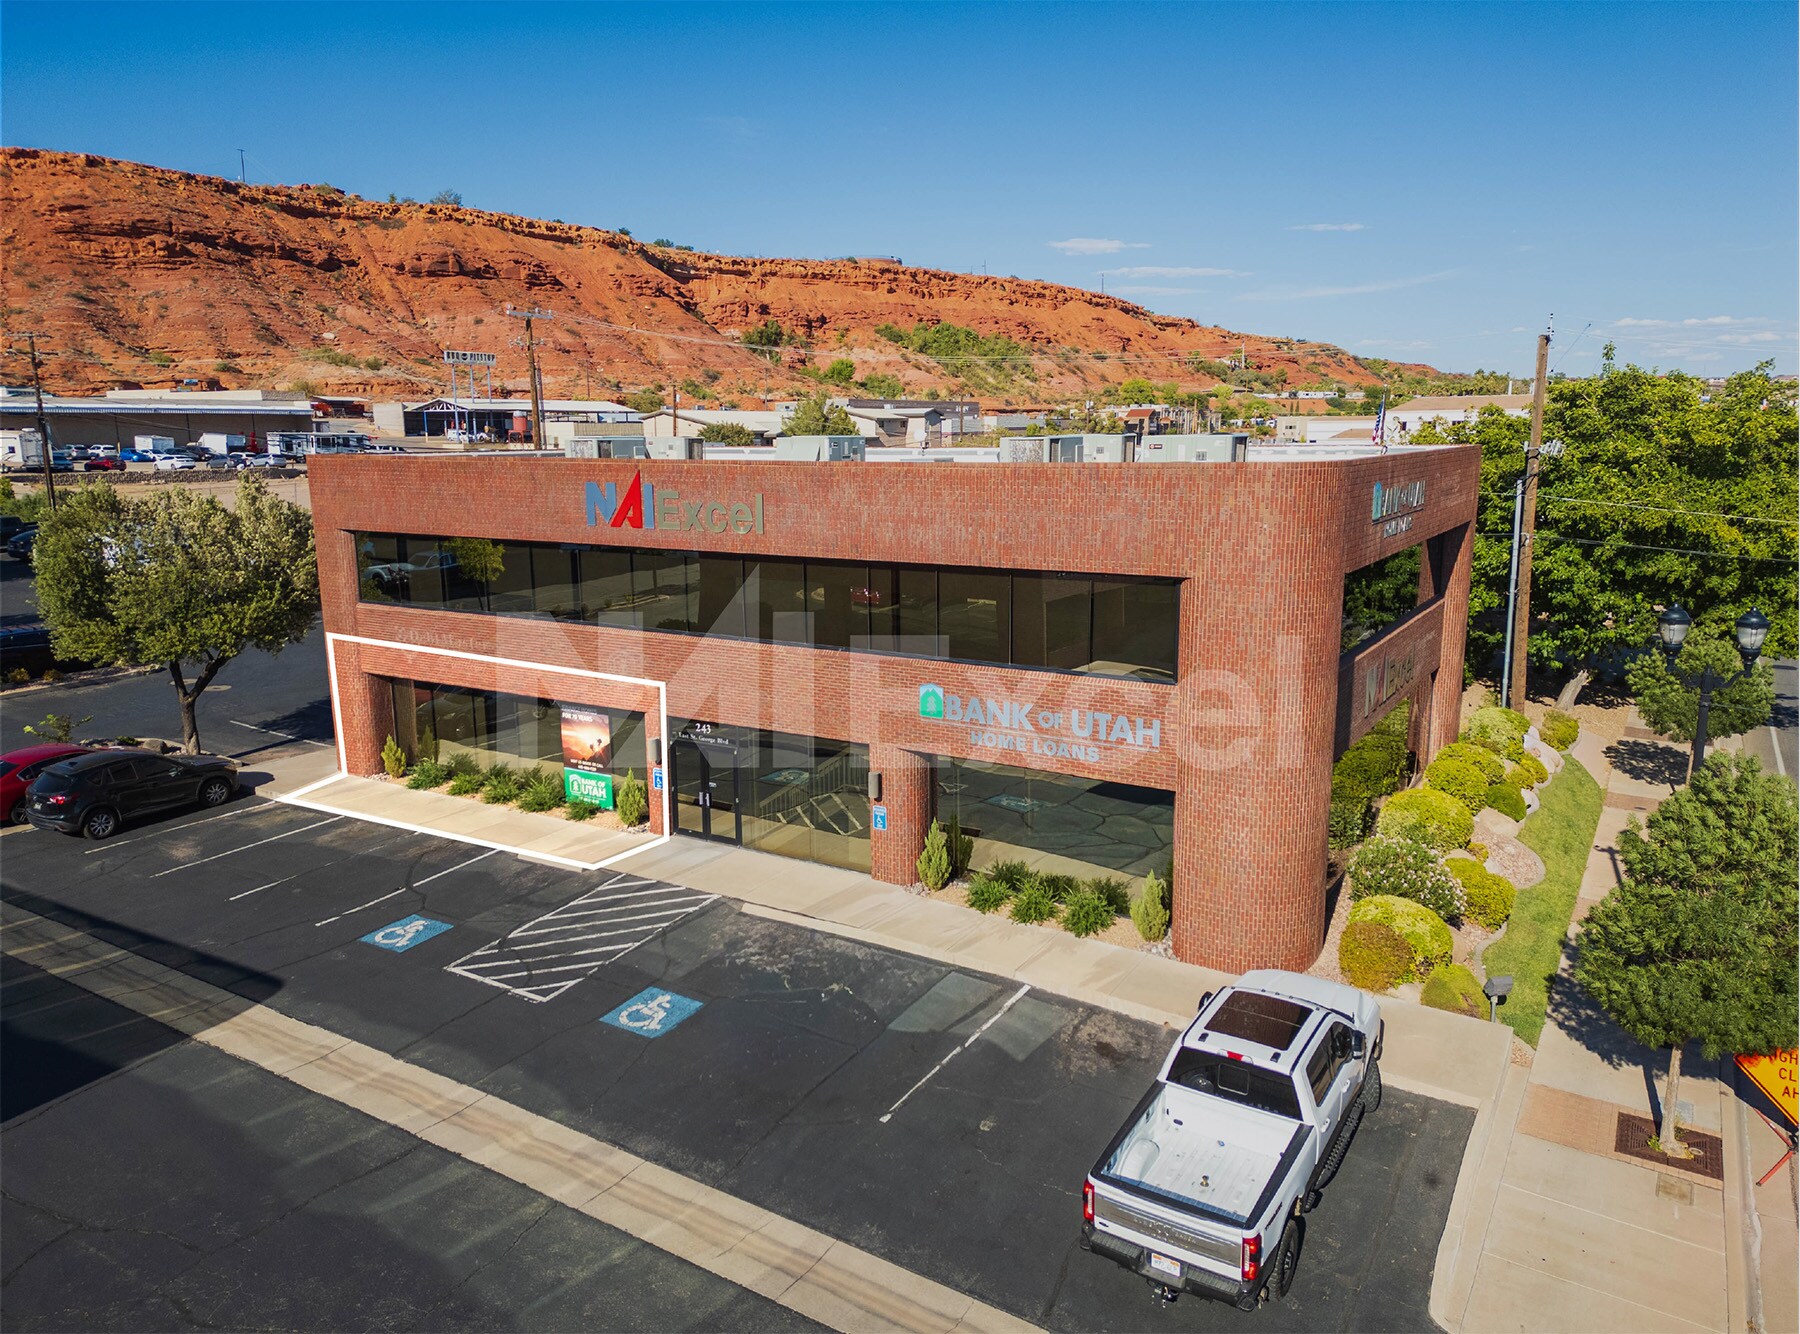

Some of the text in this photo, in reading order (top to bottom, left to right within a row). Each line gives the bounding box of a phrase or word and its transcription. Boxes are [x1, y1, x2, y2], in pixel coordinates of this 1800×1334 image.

[695, 722, 712, 734] 243
[944, 694, 1161, 748] BANK OF UTAH
[970, 731, 1100, 763] HOME LOANS
[582, 784, 607, 799] UTAH
